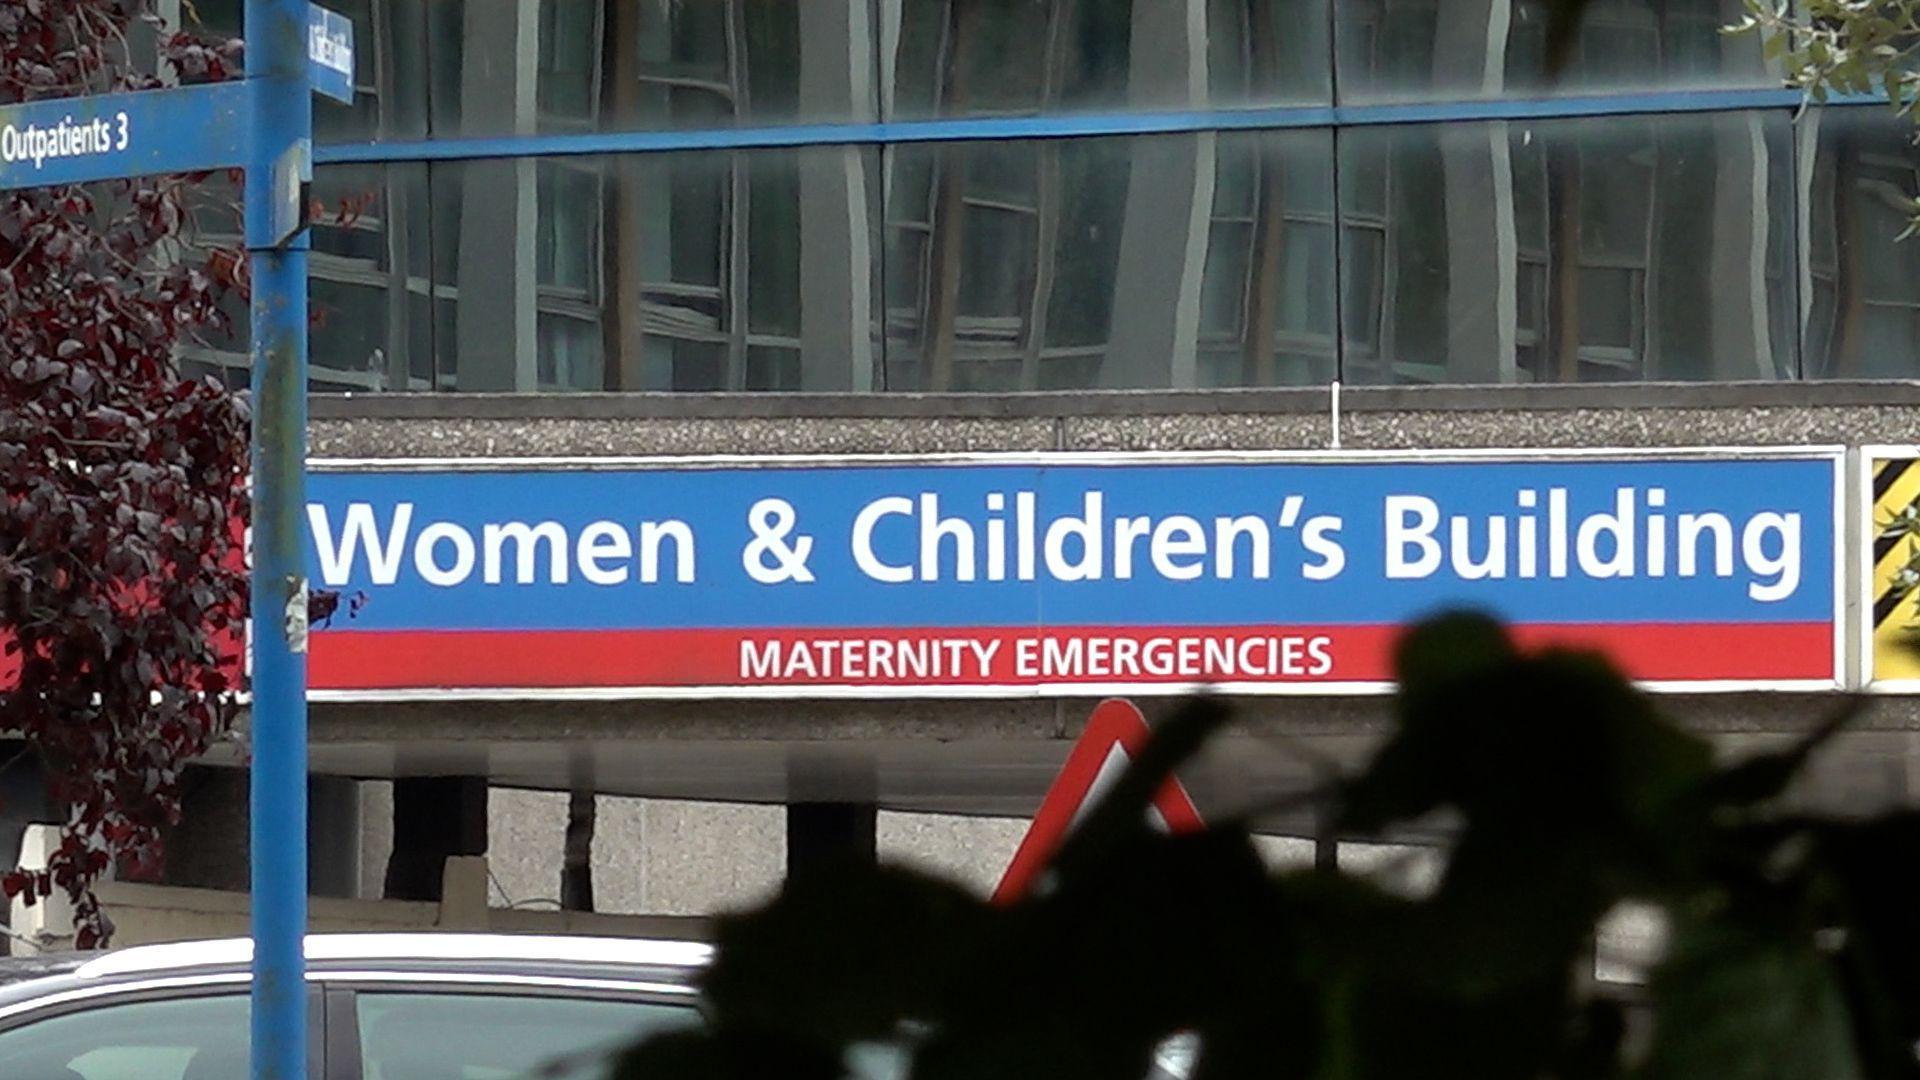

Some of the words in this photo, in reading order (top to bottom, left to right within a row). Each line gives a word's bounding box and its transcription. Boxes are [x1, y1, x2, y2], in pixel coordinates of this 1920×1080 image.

[1, 114, 111, 169] Outpatients
[115, 111, 129, 151] 3
[307, 503, 695, 586] Women
[743, 498, 814, 583] &
[851, 491, 1345, 583] Children's
[1385, 487, 1801, 602] Building
[740, 639, 1000, 678] MATERNITY
[1016, 636, 1332, 677] EMERGENCIES
